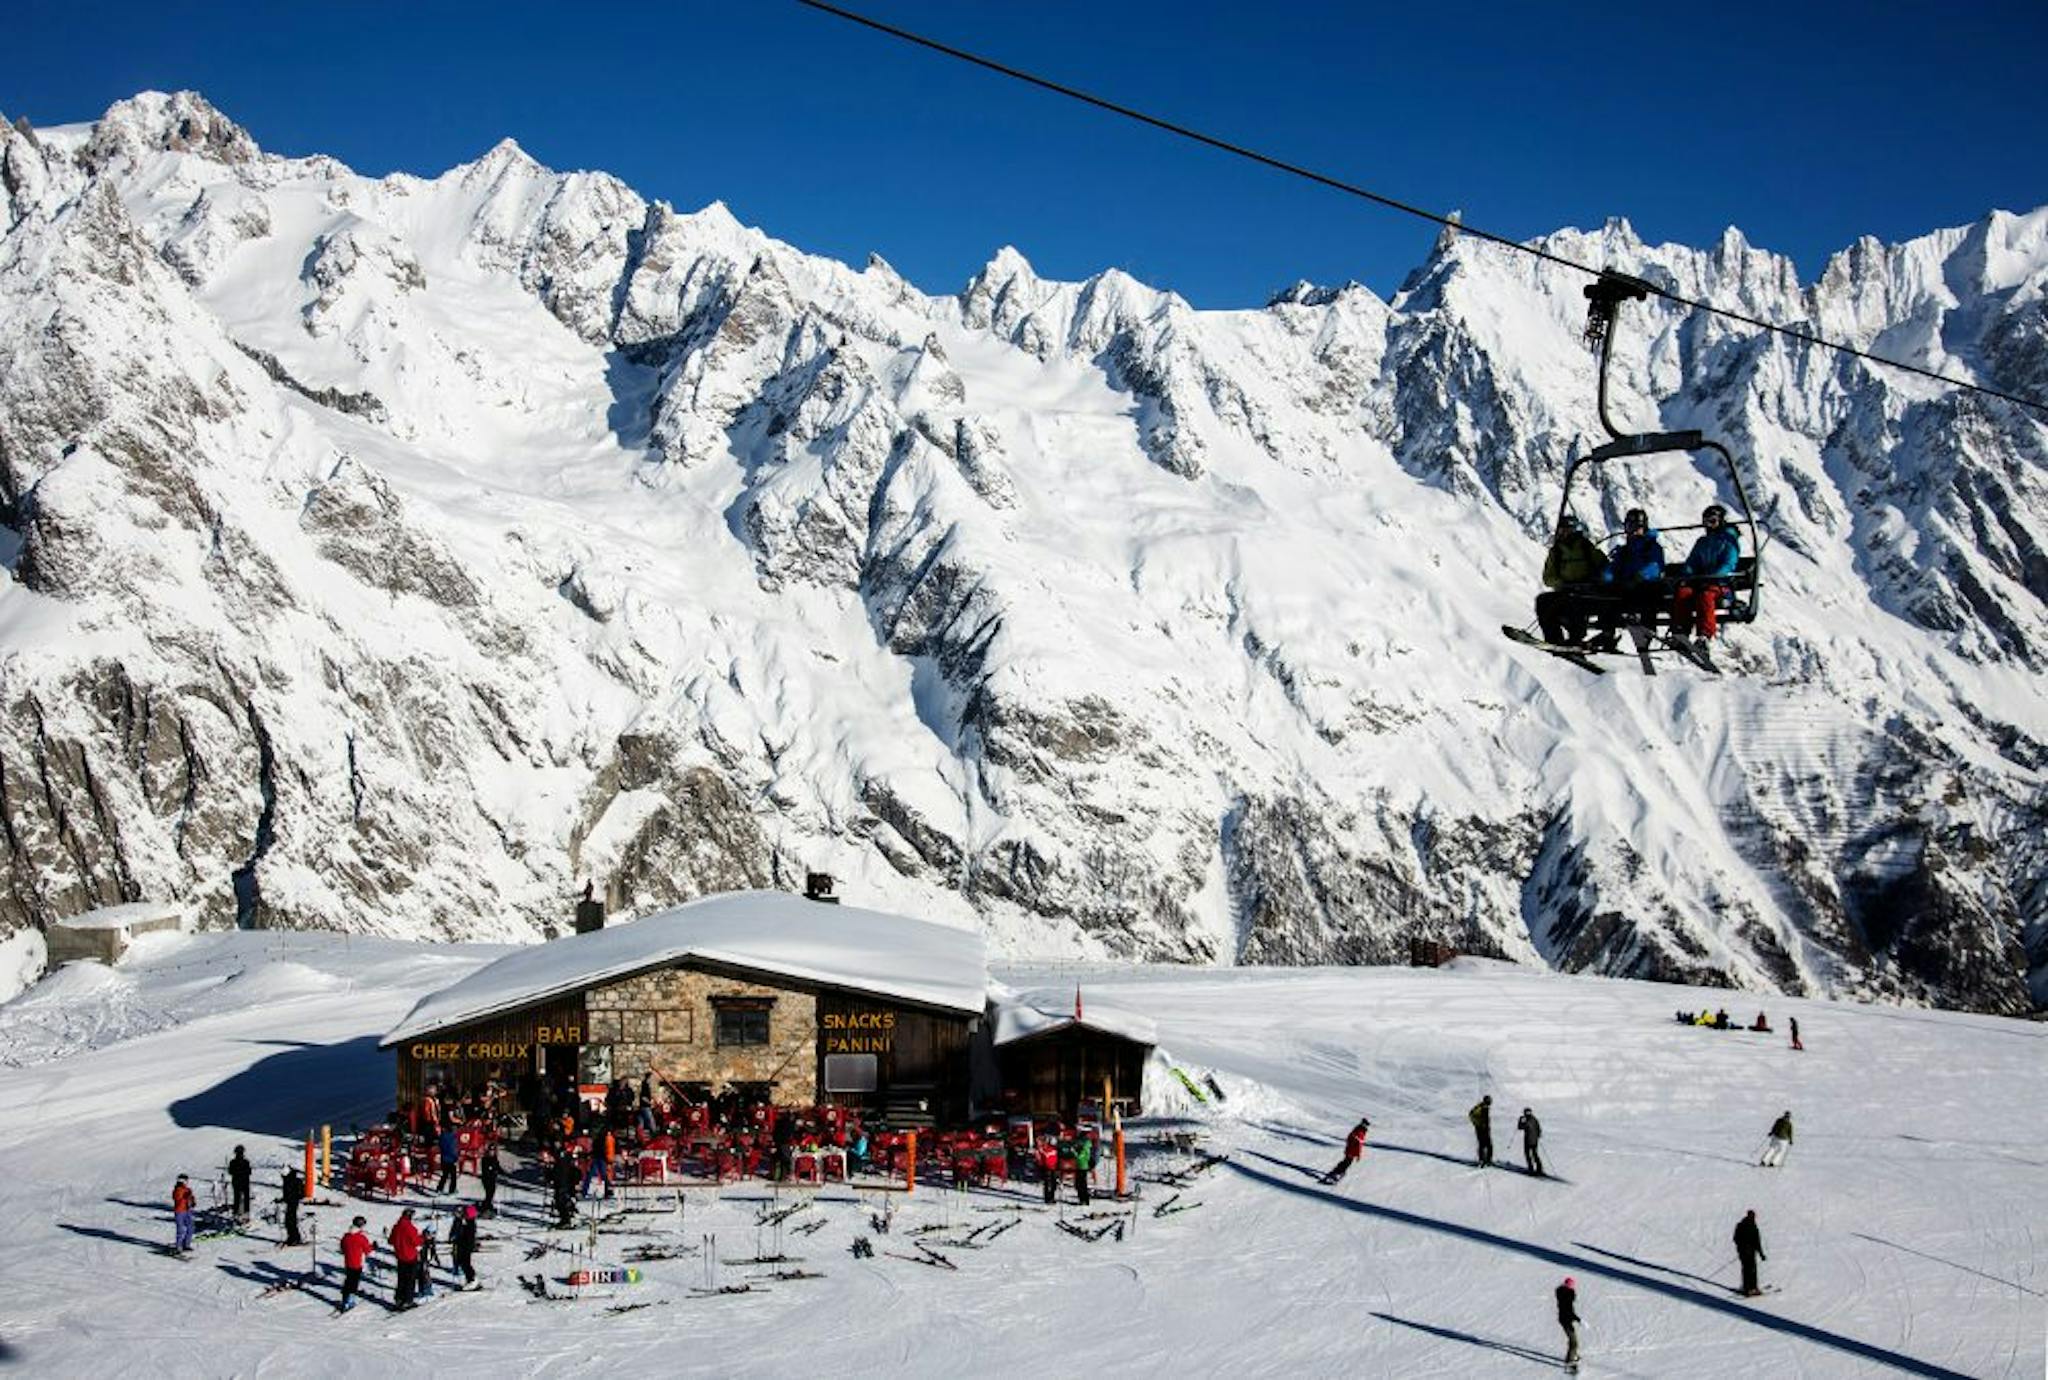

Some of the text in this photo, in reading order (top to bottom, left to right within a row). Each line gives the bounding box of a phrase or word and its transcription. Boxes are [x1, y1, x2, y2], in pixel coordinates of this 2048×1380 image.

[824, 1013, 895, 1029] SNACKS
[537, 1027, 581, 1043] BAR
[412, 1043, 528, 1059] CHEZ CROUX
[826, 1038, 891, 1051] PANINI
